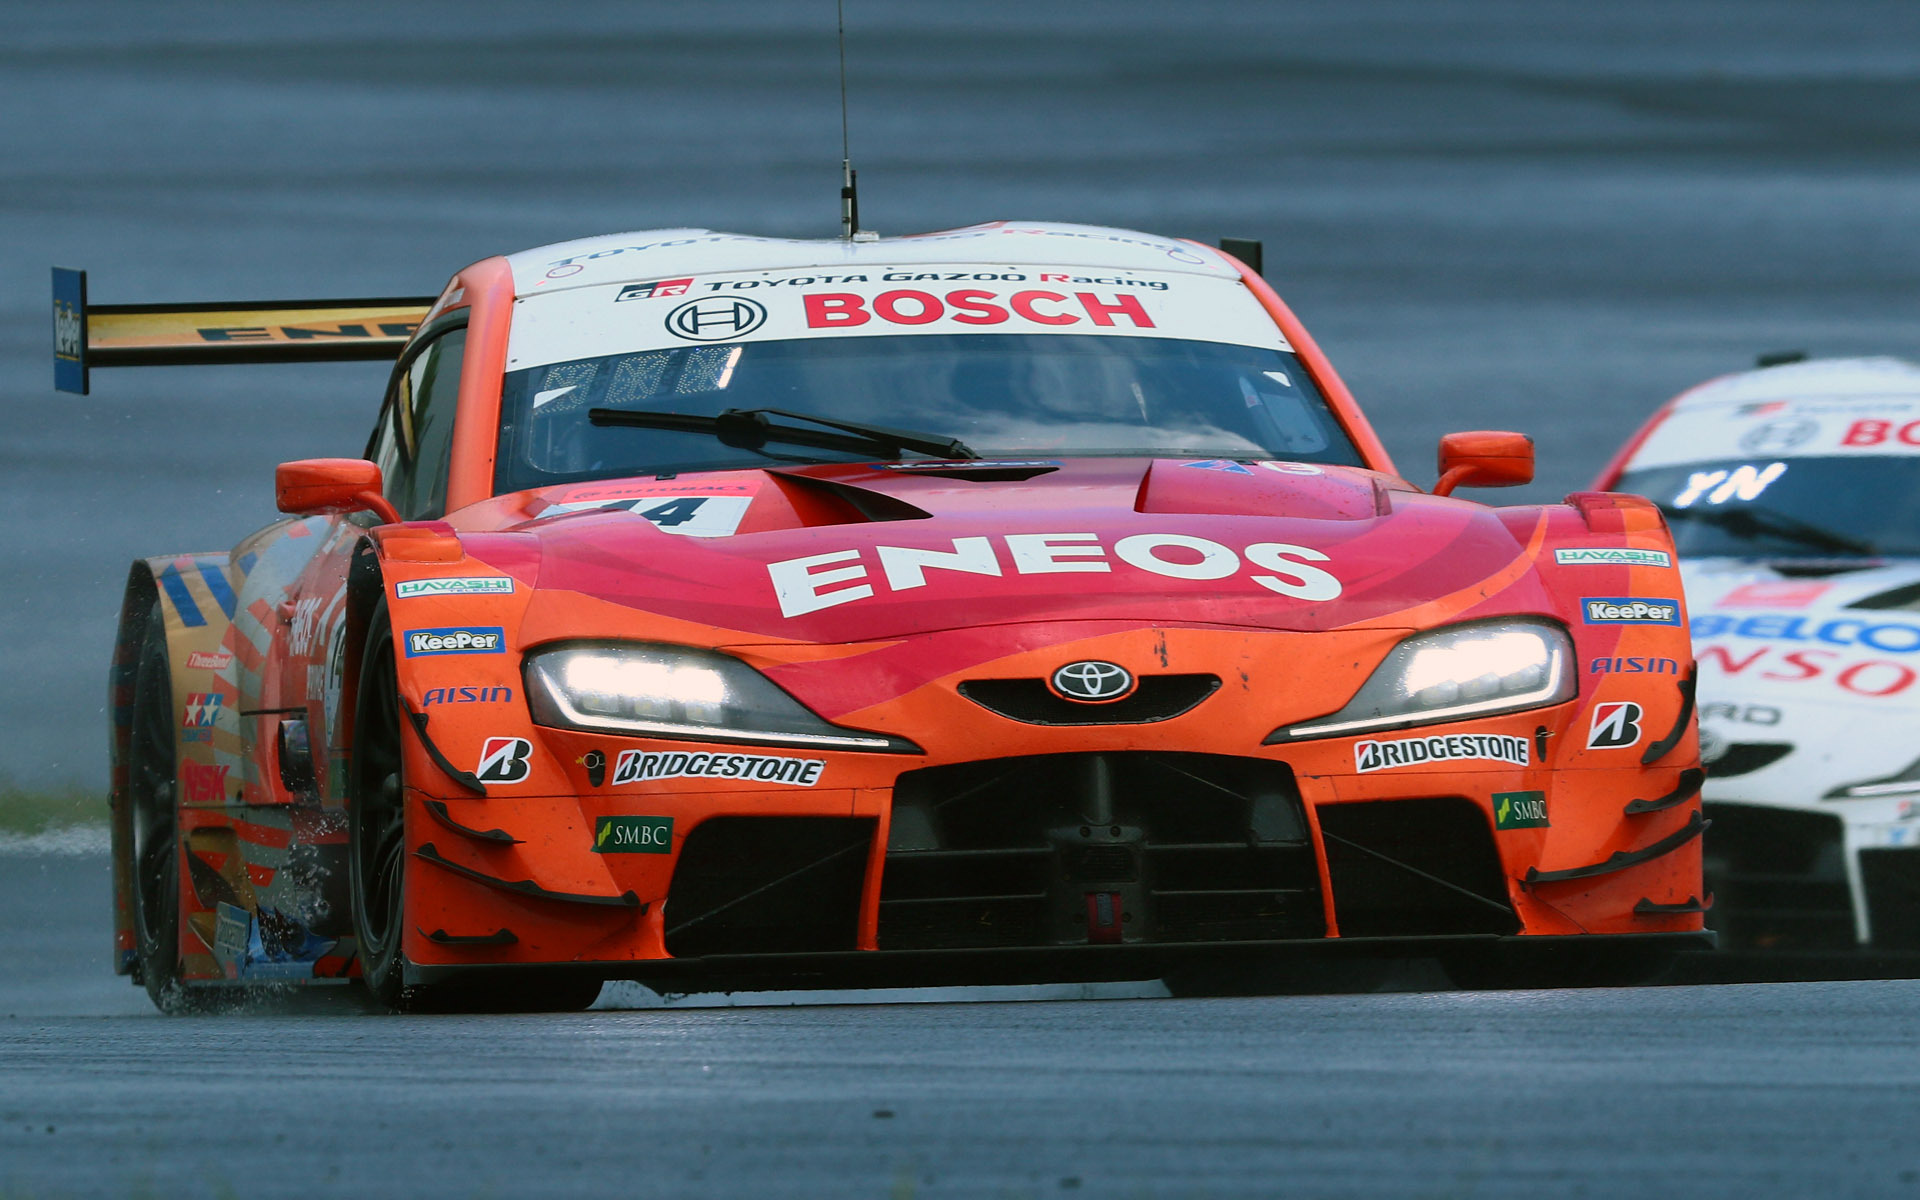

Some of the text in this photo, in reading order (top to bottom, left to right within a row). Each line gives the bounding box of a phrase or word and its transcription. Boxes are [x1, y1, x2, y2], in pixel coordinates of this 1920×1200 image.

[704, 273, 868, 291] TOYOTA
[882, 272, 1027, 283] GAZOO
[1040, 273, 1169, 292] Racing
[803, 289, 1157, 329] BOSCH
[1673, 462, 1789, 509] YN
[1560, 550, 1667, 563] HAYASHI
[767, 533, 1343, 618] ENEOS
[402, 580, 511, 594] HAYASHI
[1587, 601, 1675, 622] KeePer
[410, 631, 499, 653] KeePer
[1590, 657, 1678, 675] AISIN
[423, 686, 513, 707] AISIN
[1354, 733, 1530, 774] BRIDGESTONE
[612, 749, 826, 787] BRIDGESTONE
[1514, 799, 1547, 821] SMBC
[613, 824, 668, 846] SMBC
